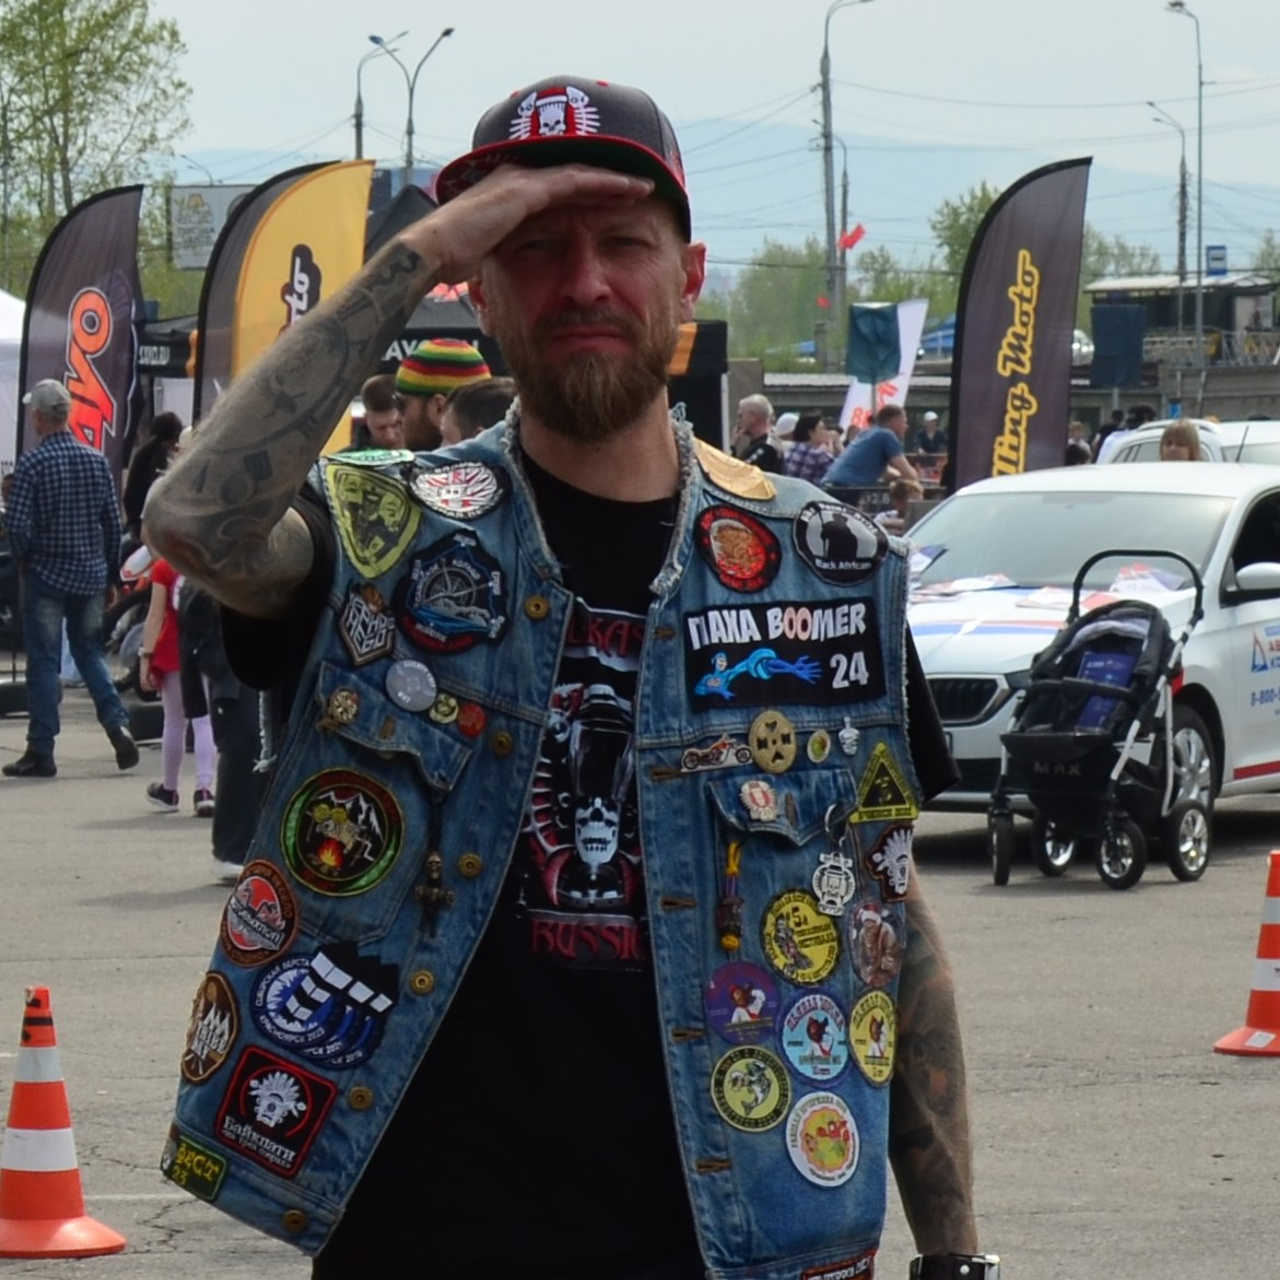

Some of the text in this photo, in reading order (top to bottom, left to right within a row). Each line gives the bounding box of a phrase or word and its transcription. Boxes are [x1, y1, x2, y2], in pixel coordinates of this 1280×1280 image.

[997, 249, 1041, 378] Moto
[766, 602, 868, 641] BOOMER
[830, 651, 870, 689] 24
[1033, 761, 1081, 776] MAX
